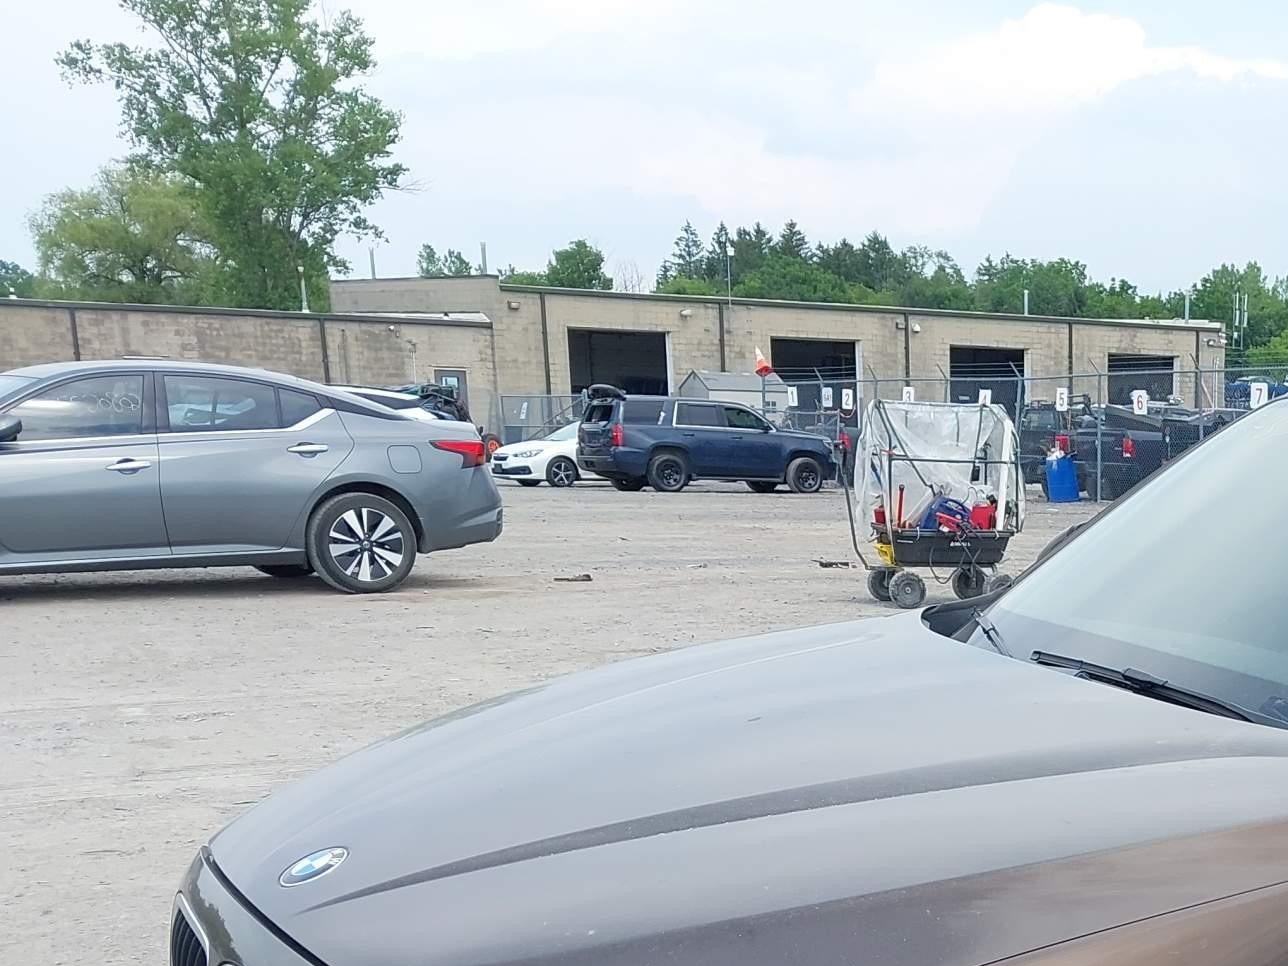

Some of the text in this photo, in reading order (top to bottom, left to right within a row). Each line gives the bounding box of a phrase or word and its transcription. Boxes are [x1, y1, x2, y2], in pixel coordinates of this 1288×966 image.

[844, 392, 851, 406] 2
[1059, 392, 1065, 408] 5
[1136, 394, 1144, 411] 6
[1255, 387, 1263, 405] 7
